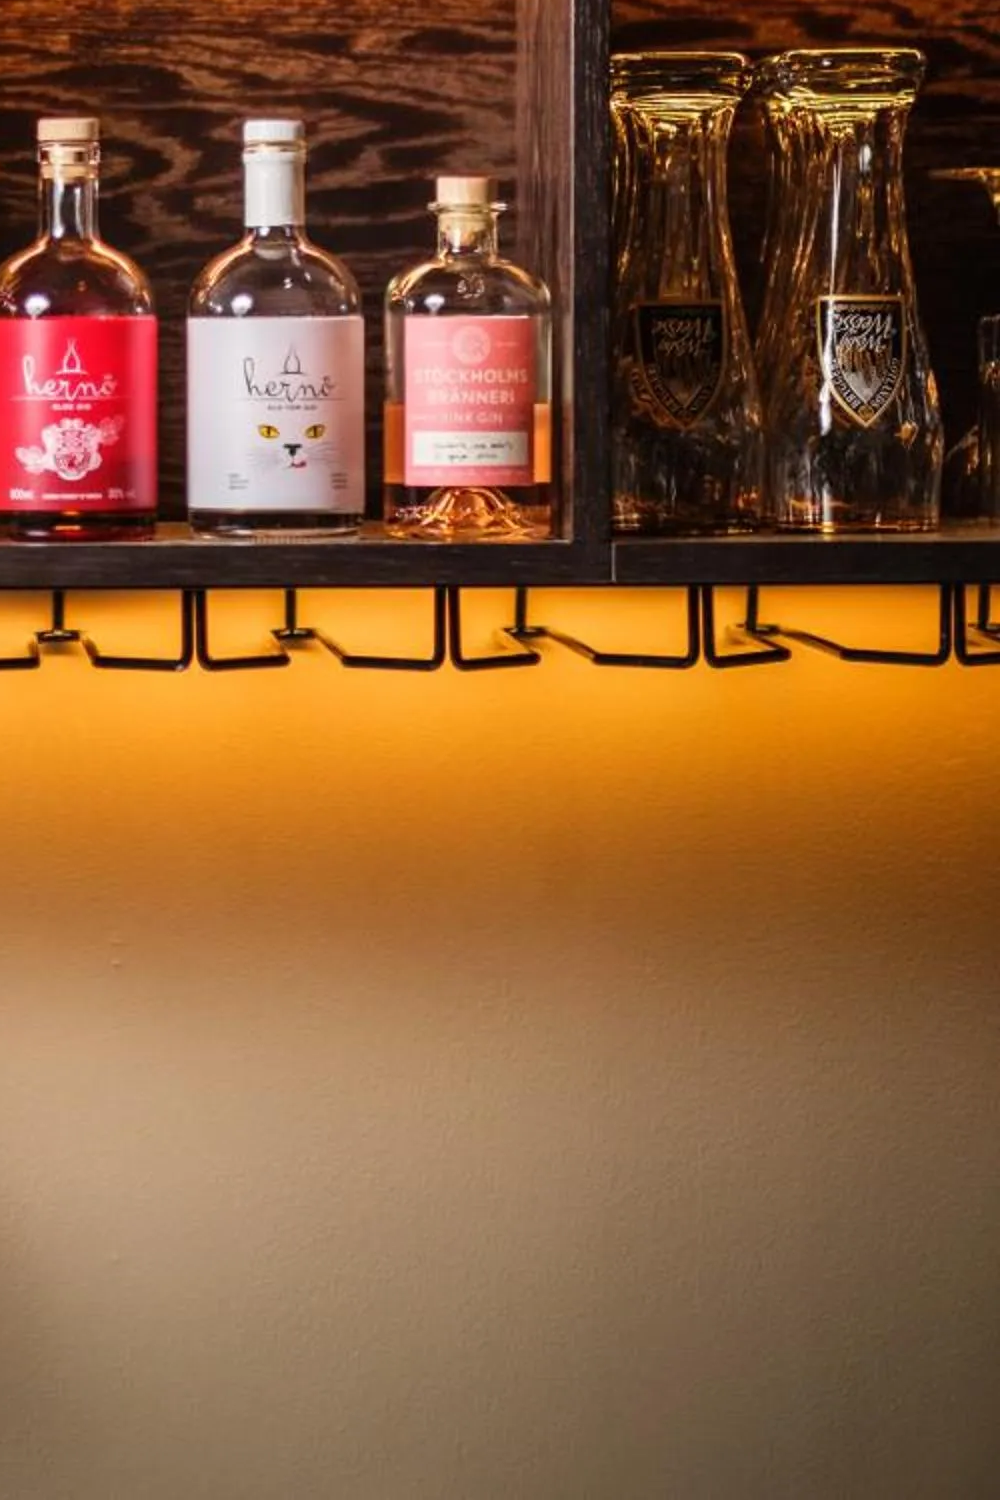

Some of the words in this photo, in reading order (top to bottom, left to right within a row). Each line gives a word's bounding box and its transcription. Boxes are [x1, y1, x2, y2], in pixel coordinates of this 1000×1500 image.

[22, 355, 118, 404] hernö
[243, 356, 337, 404] hernö
[414, 368, 528, 384] STOCKHOLMS
[427, 386, 515, 405] BRÄNNERI
